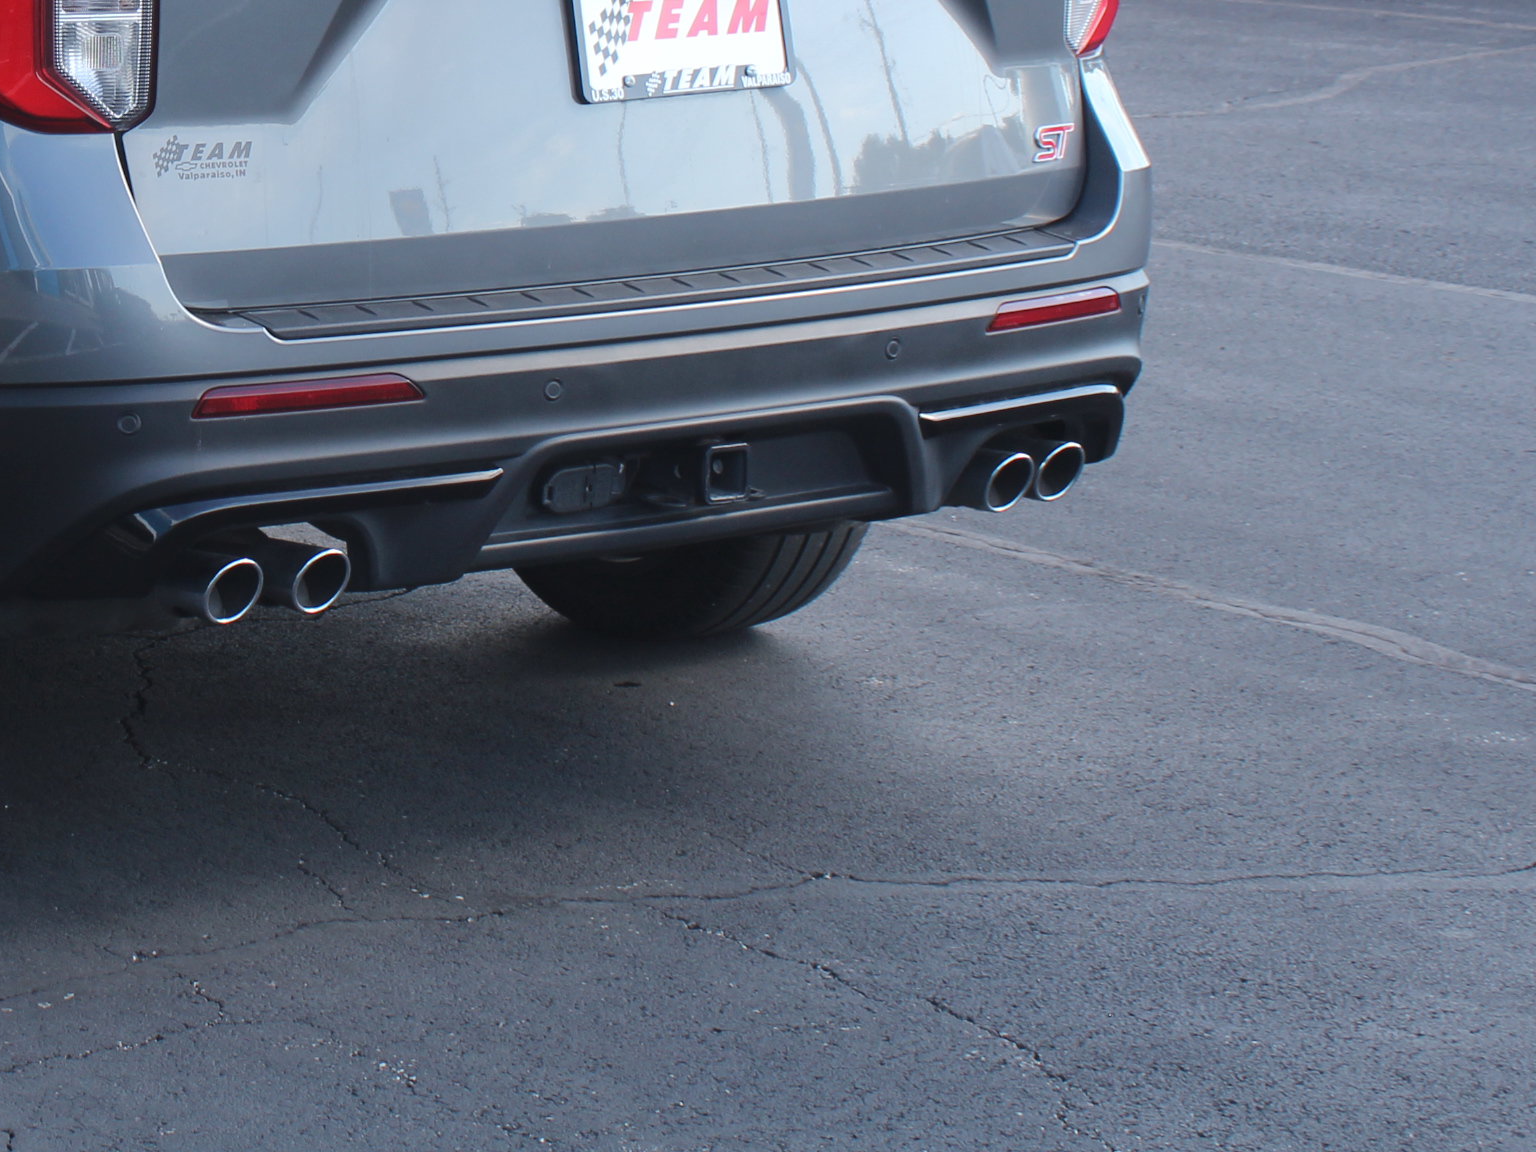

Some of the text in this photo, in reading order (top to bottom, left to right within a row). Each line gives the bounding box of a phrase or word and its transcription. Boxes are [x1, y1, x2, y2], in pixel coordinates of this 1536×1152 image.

[663, 64, 737, 94] TEAM
[741, 71, 791, 89] VALPARAISO
[175, 141, 253, 162] TEAM
[1033, 123, 1075, 163] ST
[178, 168, 246, 181] Valparaiso, IN
[199, 160, 249, 170] CHEVROLET
